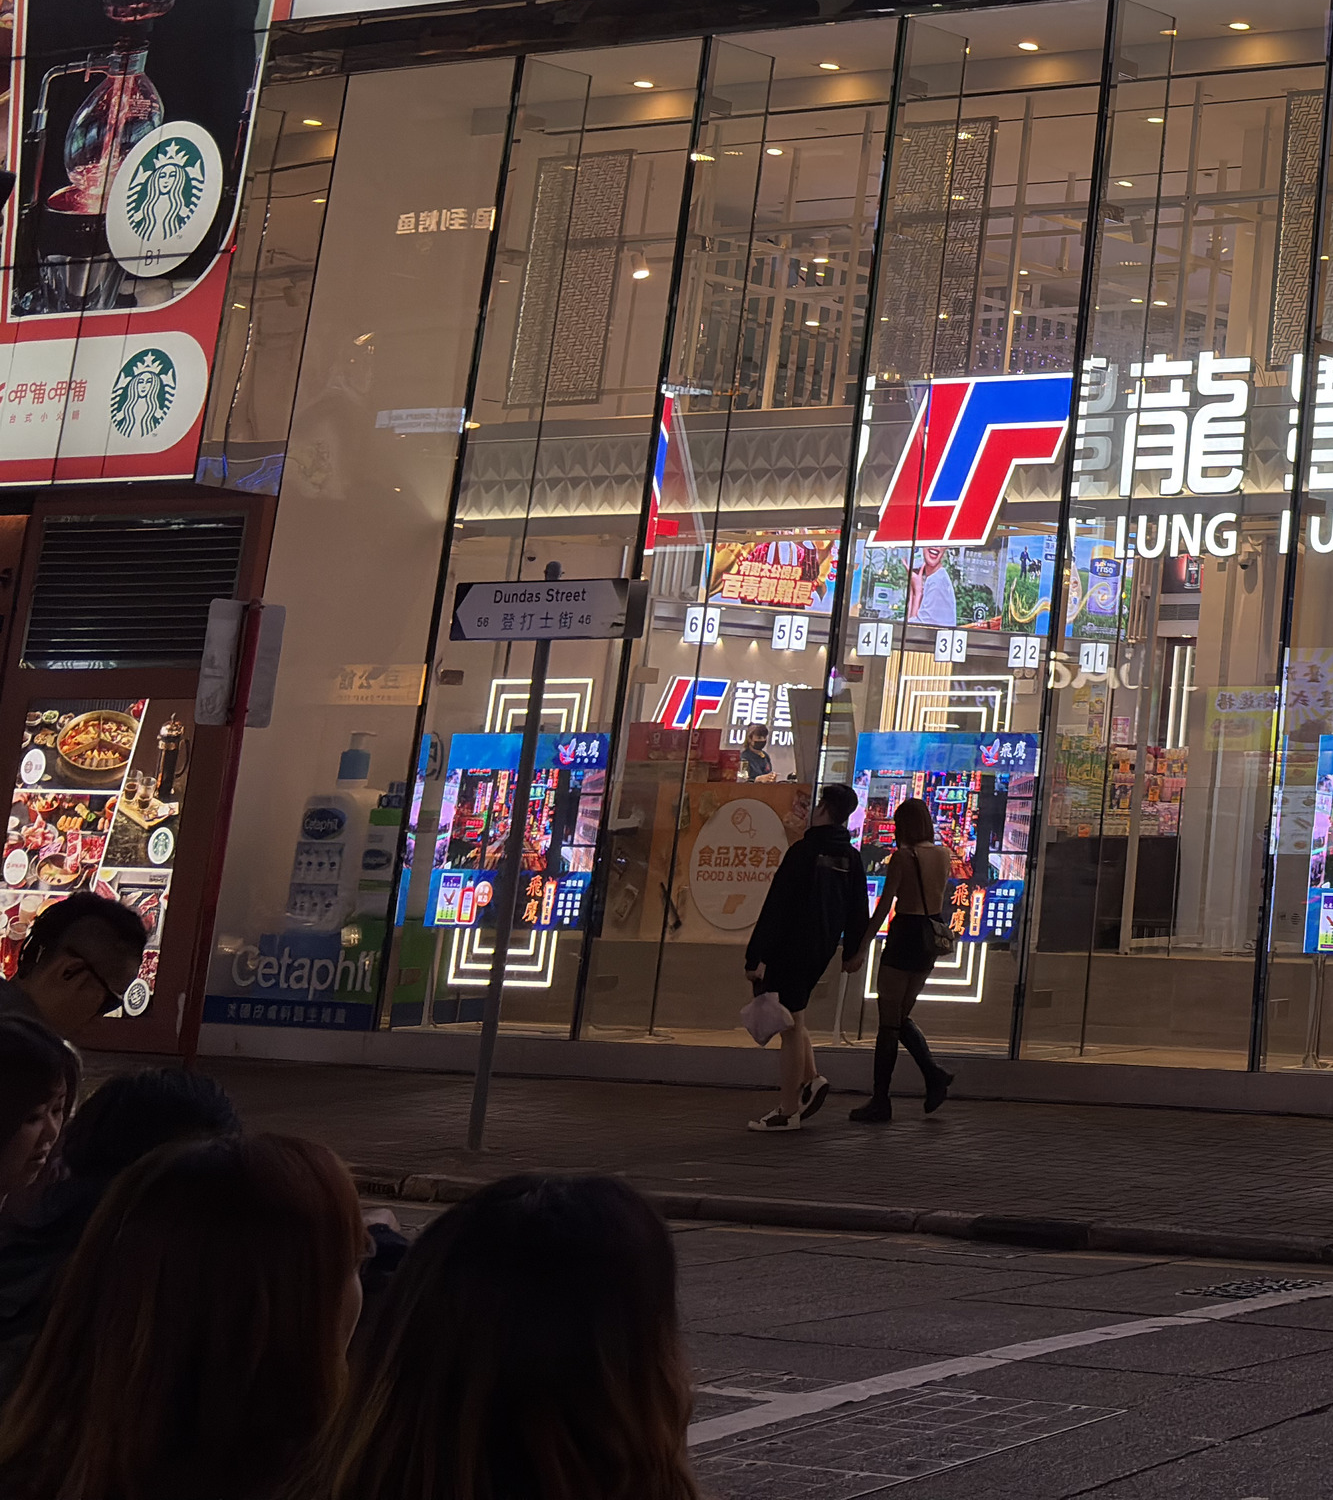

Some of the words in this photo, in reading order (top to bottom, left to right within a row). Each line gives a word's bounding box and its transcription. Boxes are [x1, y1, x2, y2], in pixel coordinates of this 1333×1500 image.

[144, 248, 161, 267] B1
[494, 589, 541, 604] Dundas
[545, 588, 587, 602] Street
[501, 611, 574, 631] 登打士街
[578, 614, 592, 626] 46
[698, 845, 782, 868] 食品及零食
[697, 870, 725, 882] FOOD
[727, 871, 733, 882] &
[232, 946, 373, 1001] Cetaphil
